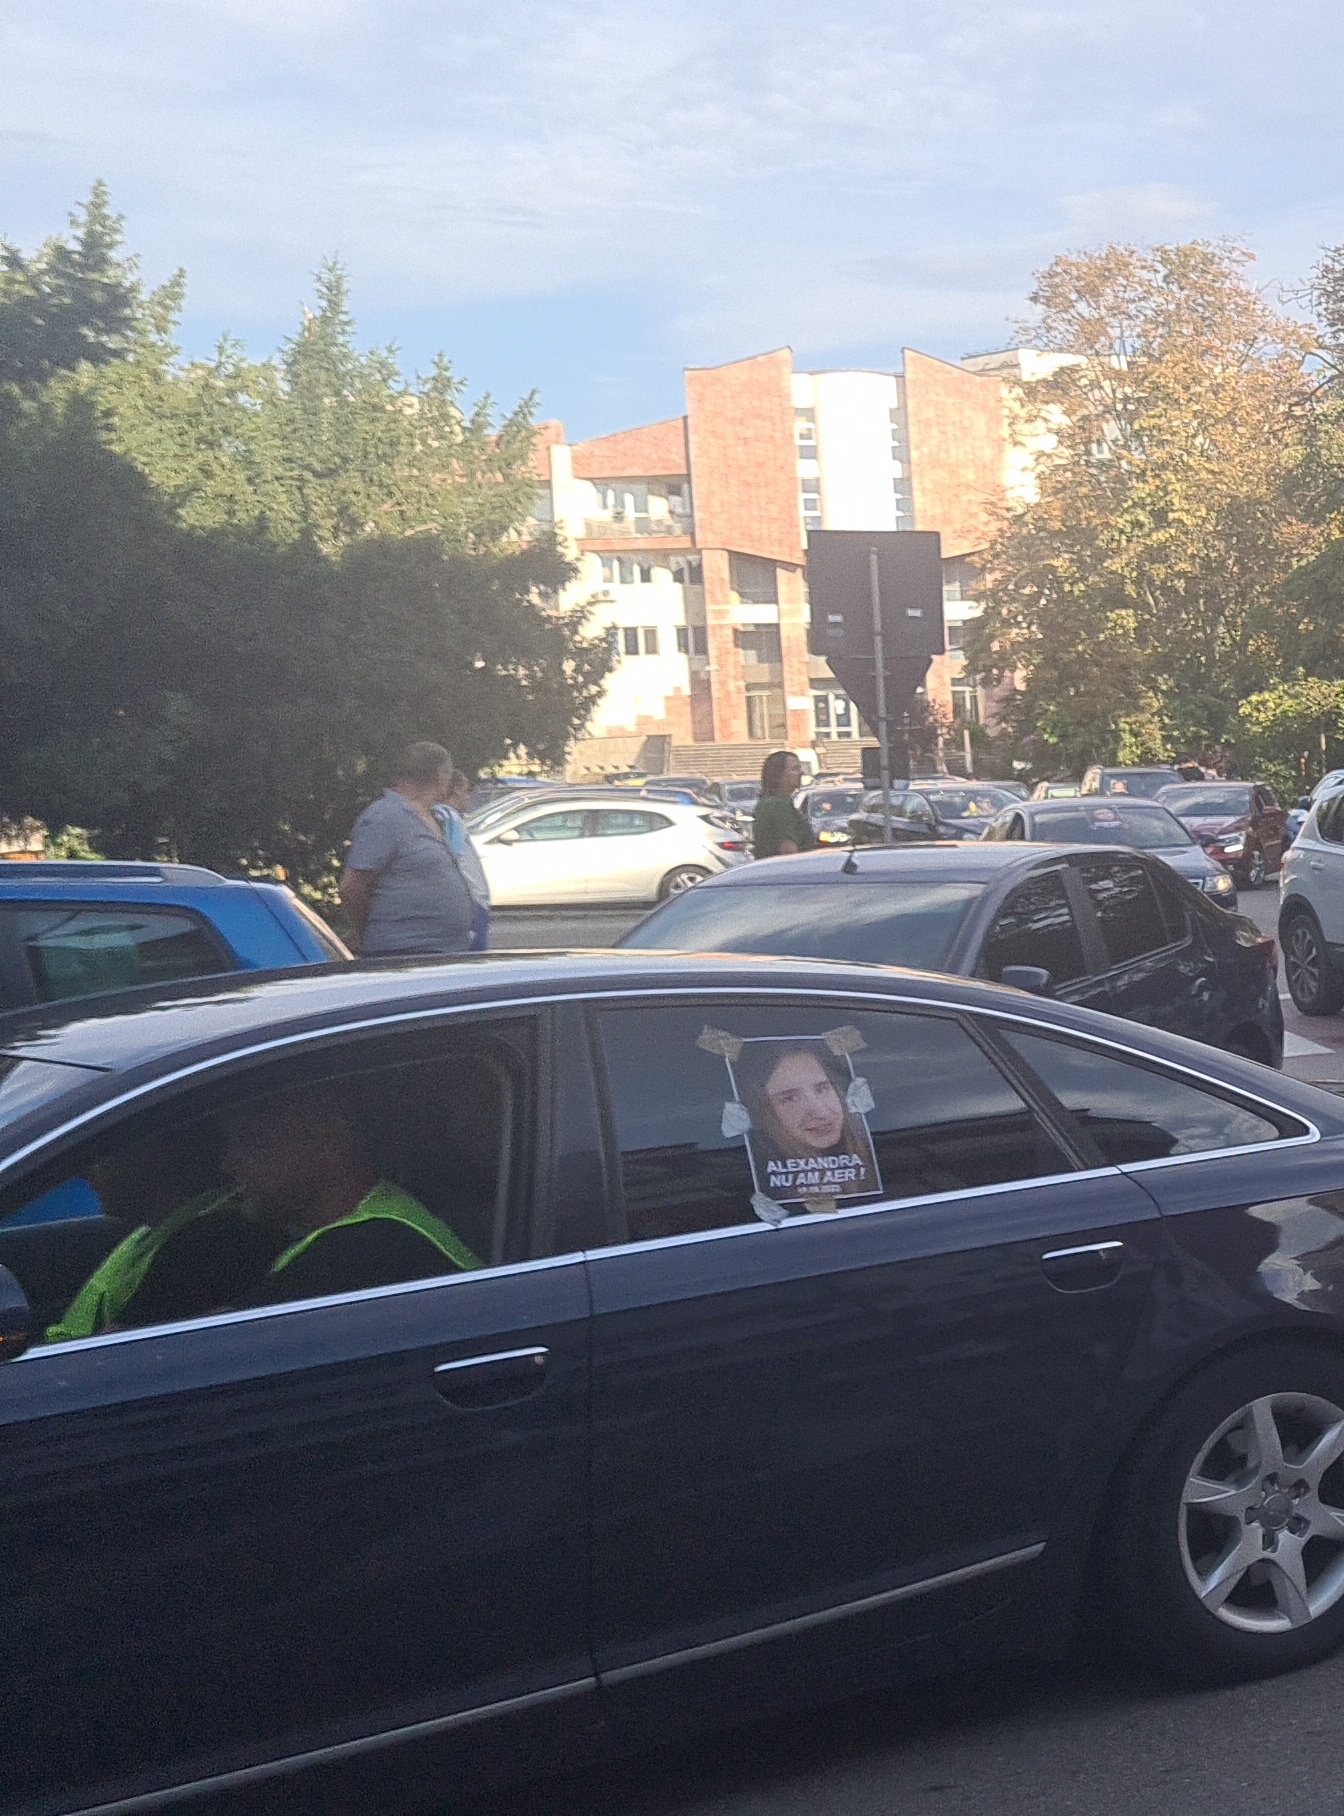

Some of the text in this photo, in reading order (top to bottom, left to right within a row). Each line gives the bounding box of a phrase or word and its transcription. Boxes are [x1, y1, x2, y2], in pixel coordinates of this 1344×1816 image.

[766, 1153, 863, 1174] ALEXANDRA
[769, 1174, 793, 1188] NU
[795, 1171, 820, 1186] AM
[822, 1168, 856, 1184] AER
